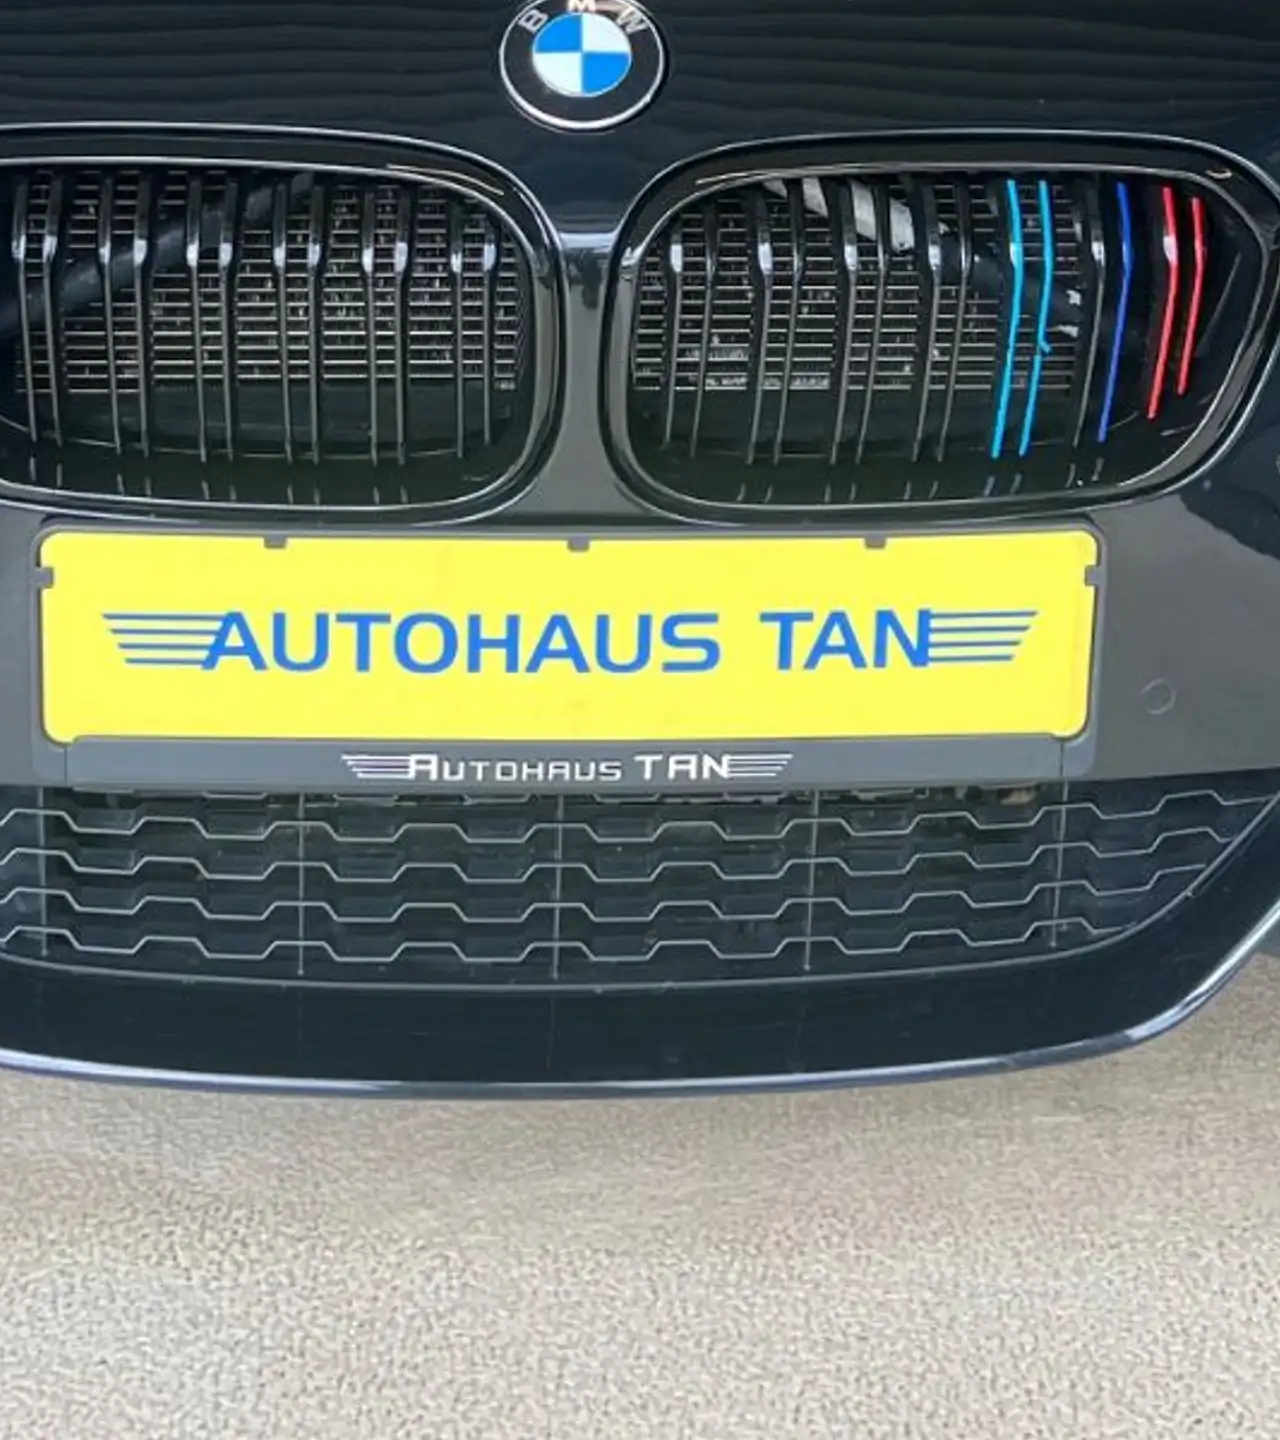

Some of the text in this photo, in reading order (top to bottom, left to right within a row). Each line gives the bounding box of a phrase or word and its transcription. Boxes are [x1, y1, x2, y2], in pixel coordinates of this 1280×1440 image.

[201, 607, 931, 676] AUTOHAUS TAN
[633, 752, 730, 781] TAN
